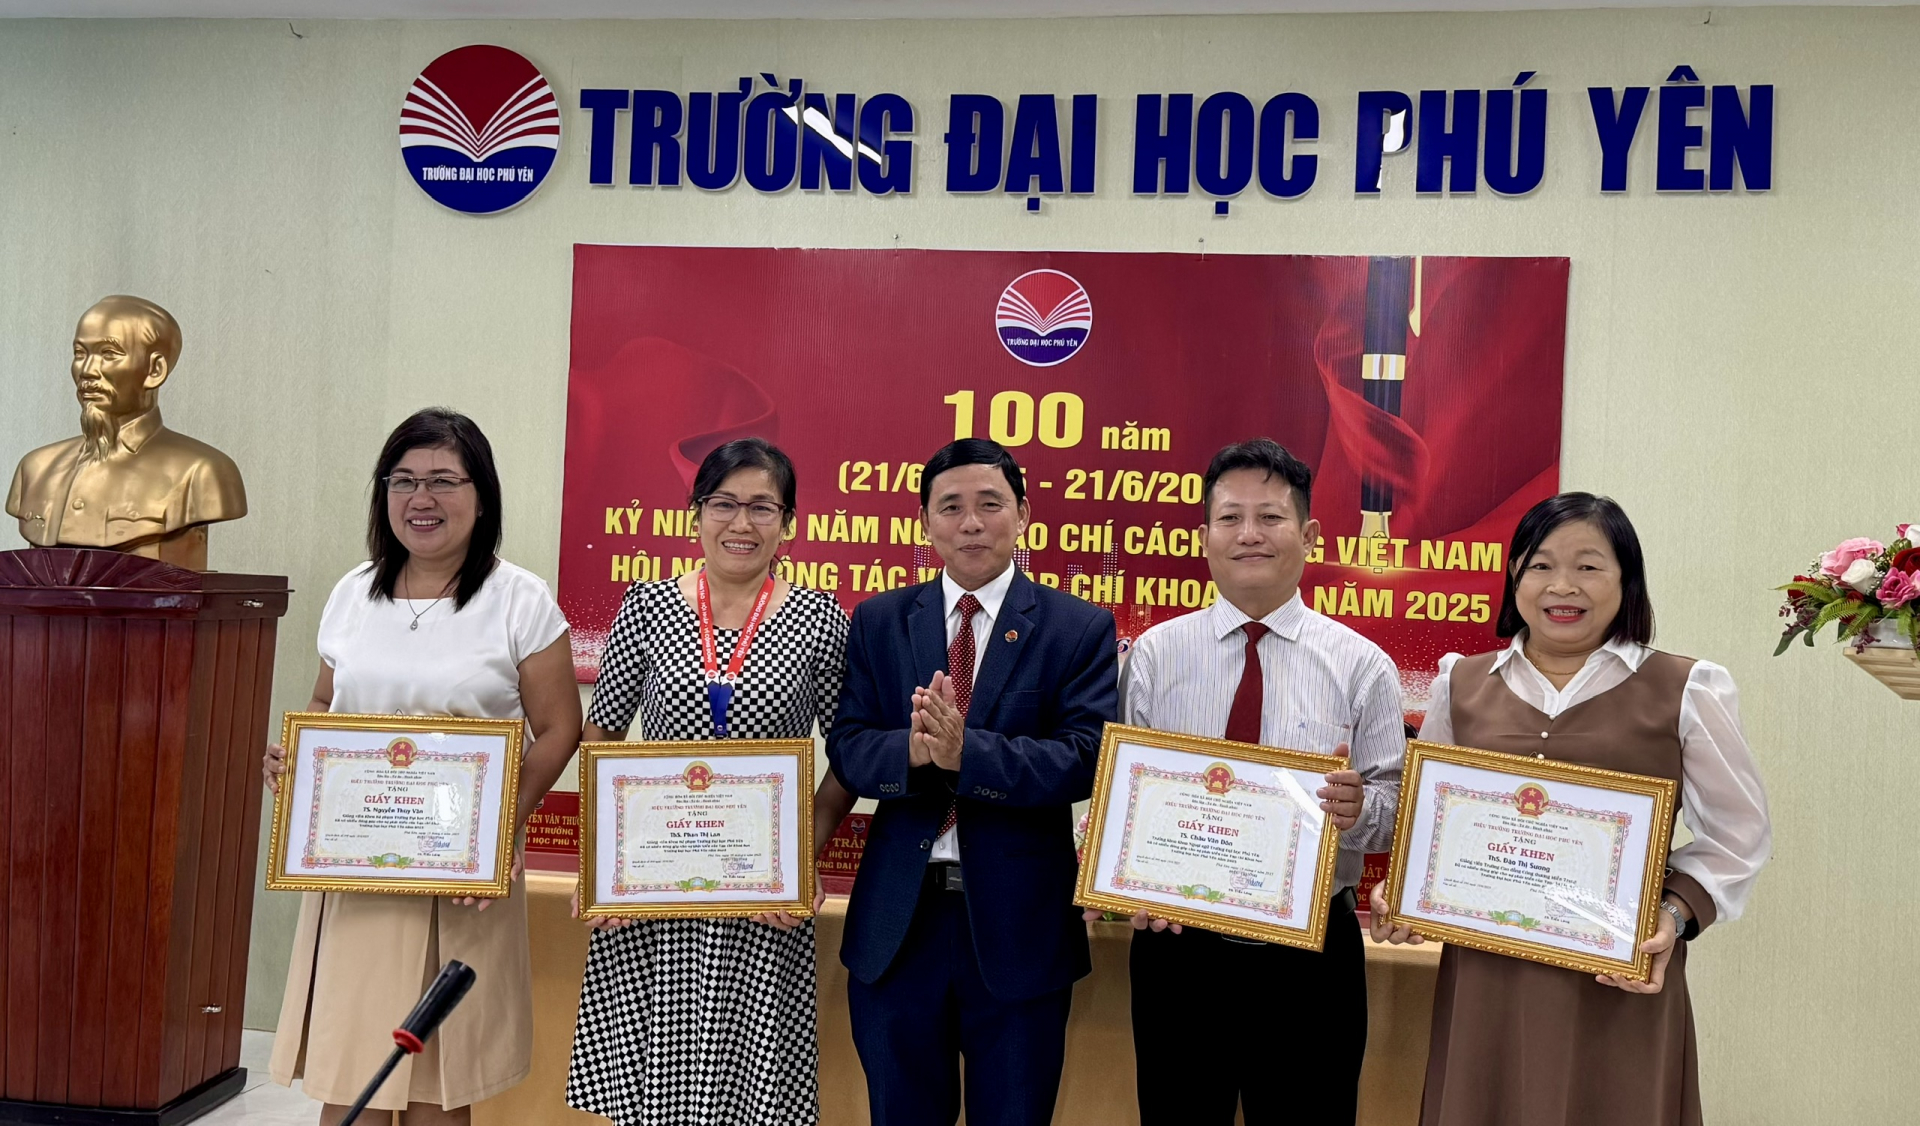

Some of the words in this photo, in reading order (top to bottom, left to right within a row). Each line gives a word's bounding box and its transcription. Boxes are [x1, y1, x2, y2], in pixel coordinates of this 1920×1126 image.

[580, 72, 914, 195] TRƯỜNG
[944, 93, 1097, 213] ĐẠI
[1133, 91, 1319, 216] HỌC
[1354, 71, 1548, 195] PHÚ
[1587, 65, 1774, 194] YÊN
[459, 167, 474, 183] ĐẠI
[477, 167, 495, 183] HỌC
[497, 166, 515, 182] PHÚ
[518, 166, 534, 182] YÊN
[944, 390, 1084, 449] 100
[1102, 421, 1171, 452] năm
[605, 499, 644, 535] KỶ
[807, 509, 880, 544] NĂM
[1059, 519, 1115, 553] CHÍ
[1336, 531, 1410, 574] VIỆT
[1419, 540, 1503, 572] NAM
[1071, 570, 1125, 604] CHÍ
[1135, 577, 1219, 609] KHOA
[1314, 581, 1394, 618] NĂM
[1405, 591, 1490, 624] 2025
[364, 792, 391, 804] GIẤY
[394, 796, 425, 805] KHEN
[666, 818, 692, 829] GIẤY
[695, 820, 725, 828] KHEN
[1177, 819, 1205, 832] GIẤY
[1208, 824, 1240, 837] KHEN
[1487, 842, 1517, 855] GIẤY
[1520, 848, 1555, 862] KHEN
[1488, 855, 1501, 863] ThS.
[1518, 860, 1528, 869] Thị
